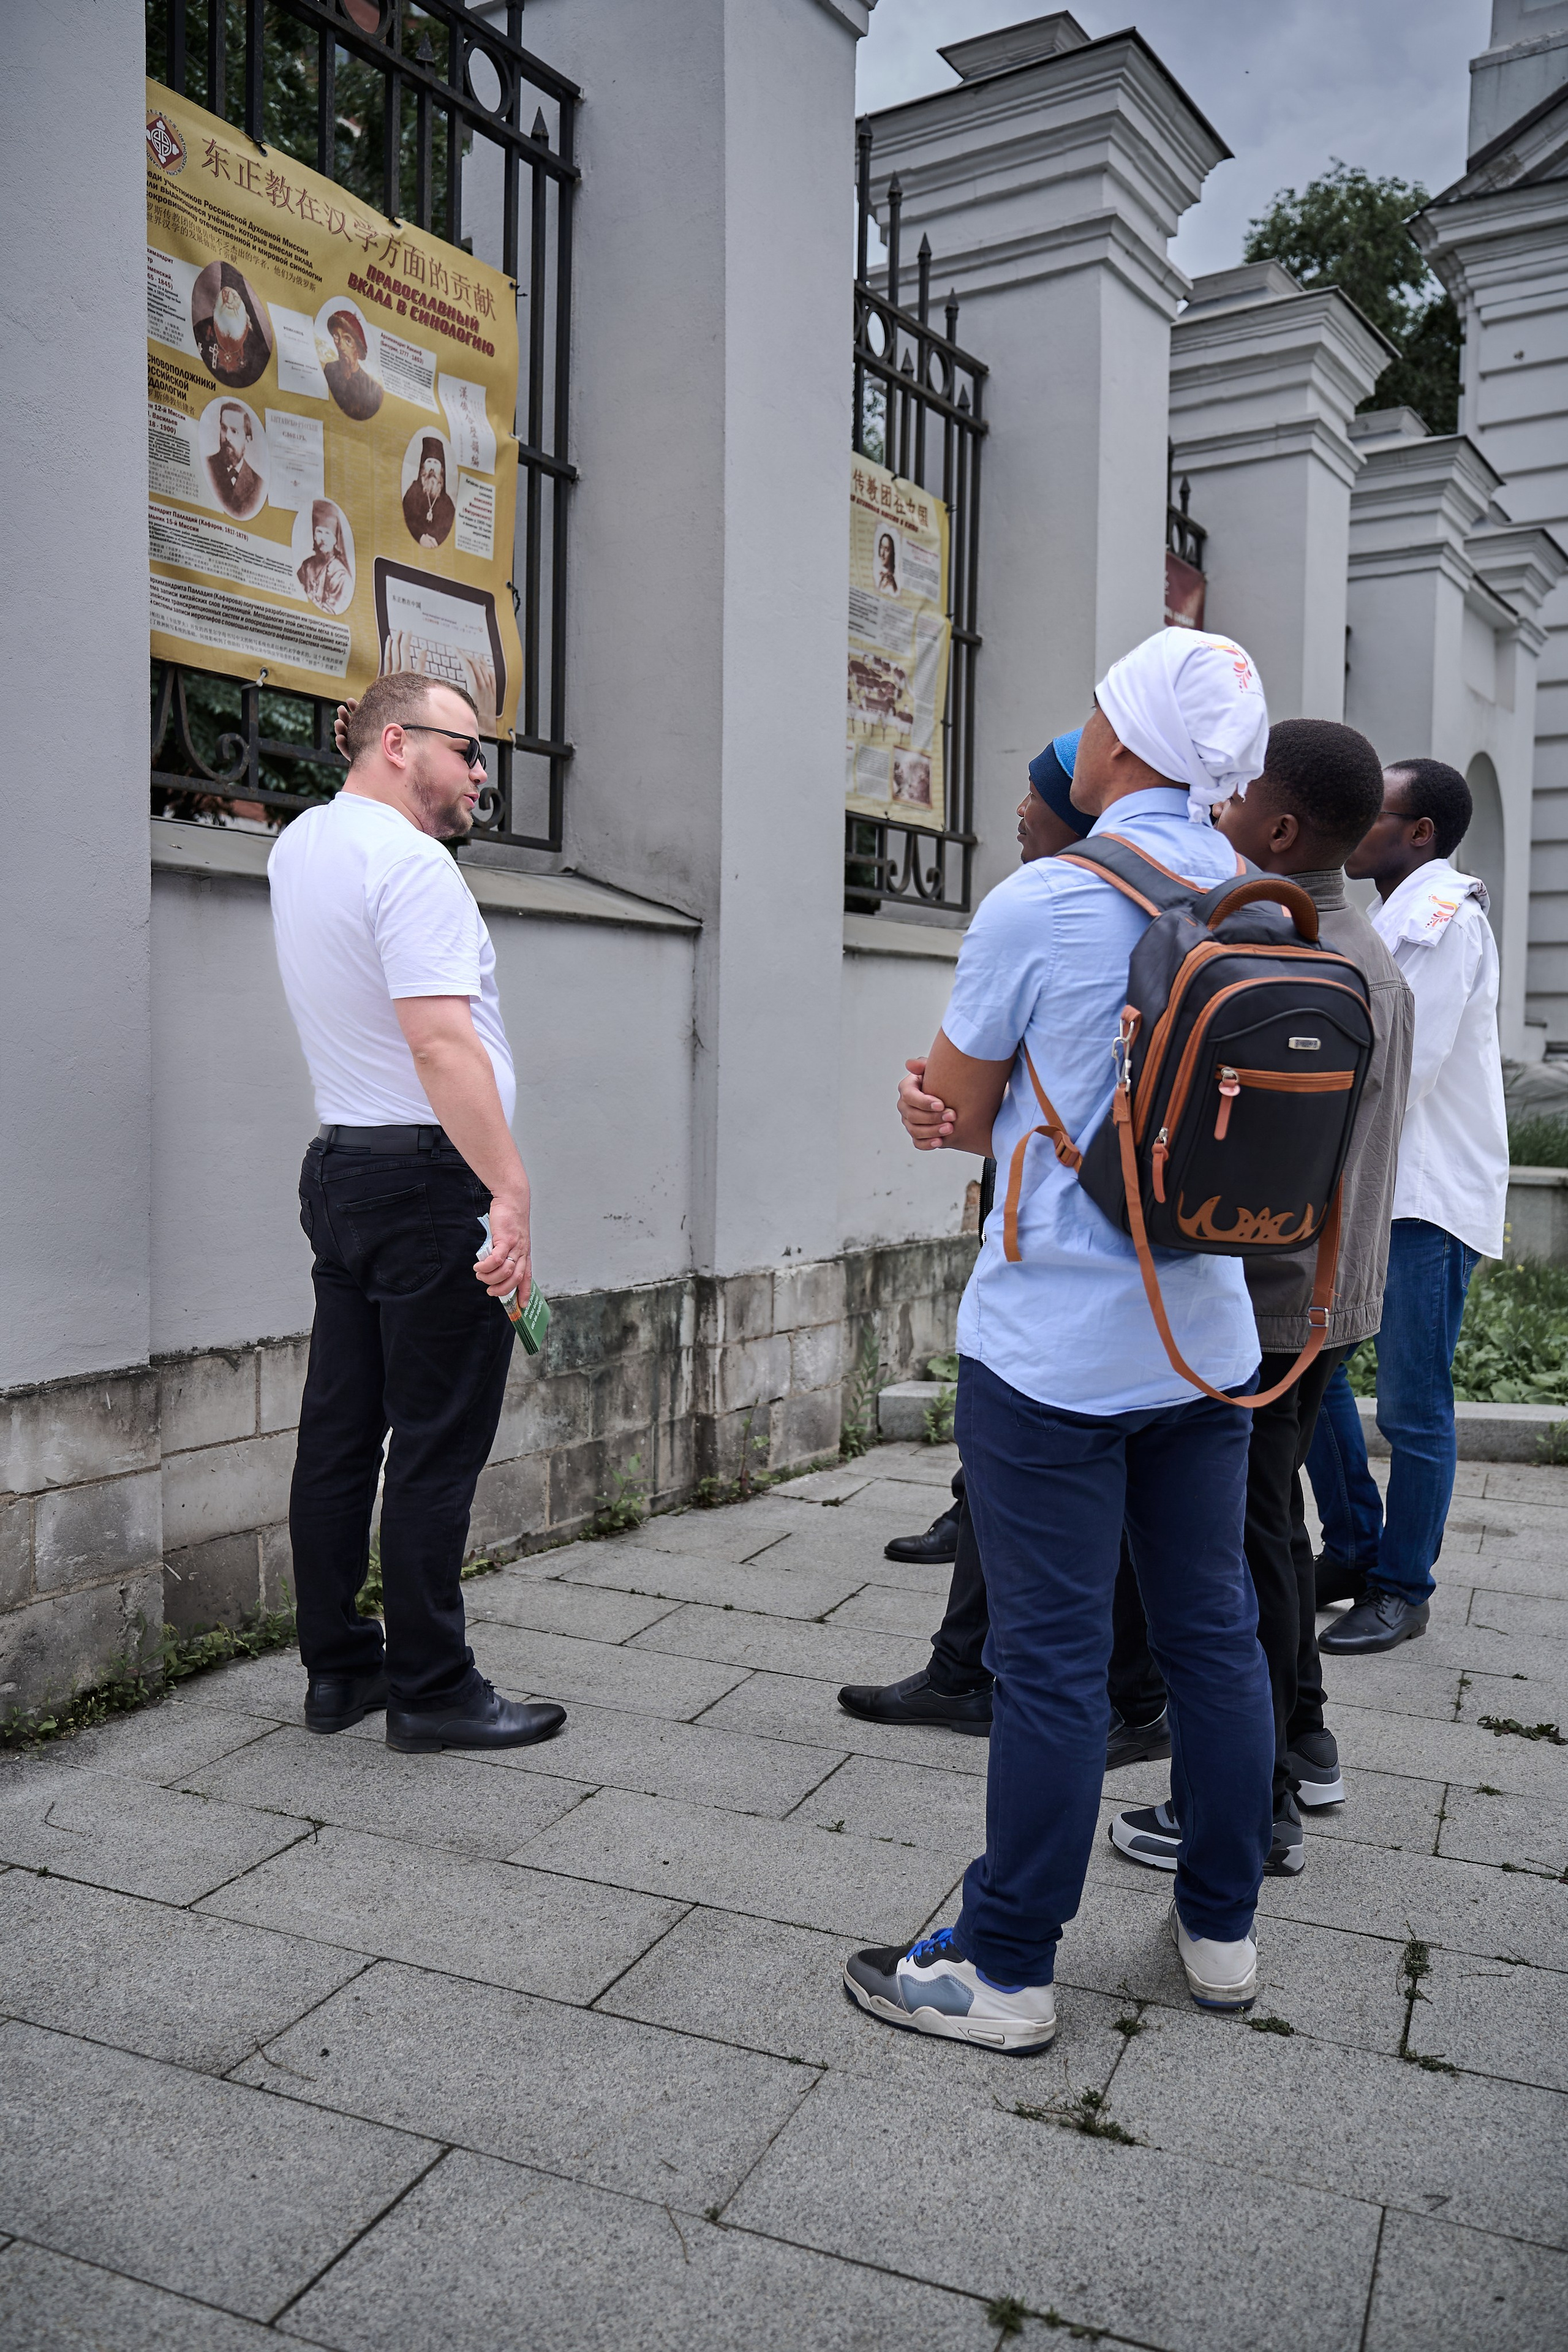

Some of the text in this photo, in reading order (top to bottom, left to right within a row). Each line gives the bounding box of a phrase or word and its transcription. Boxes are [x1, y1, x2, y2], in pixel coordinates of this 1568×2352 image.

[146, 170, 309, 256] еди участников Российской Духовной Миссии
[160, 186, 206, 217] выдающиеся
[208, 213, 236, 233] учёные,
[239, 227, 267, 246] которые
[269, 242, 293, 258] внесли
[295, 254, 313, 269] вклад
[202, 138, 496, 321] 东正教在汉学方面的贡献
[199, 218, 251, 248] отечественной
[258, 247, 288, 266] мировой
[290, 262, 323, 282] синологии
[158, 277, 173, 290] 1845)
[366, 264, 480, 334] ПРАВОСЛАВНЫЙ
[347, 272, 496, 357] ВКЛАД В СИНОЛОГИЮ
[153, 412, 178, 426] Васильев
[154, 404, 167, 413] 12-й
[168, 409, 186, 421] Миссии
[160, 424, 176, 435] 1900)
[173, 511, 198, 523] Палладий
[198, 519, 224, 532] (Кафаров,
[179, 522, 199, 532] Миссии
[153, 600, 172, 611] системы
[173, 607, 190, 616] записи
[190, 612, 221, 624] иероглифов
[225, 620, 249, 631] помощью
[249, 625, 276, 638] латинского
[276, 633, 298, 644] алфавита
[298, 638, 320, 648] (система
[160, 588, 178, 597] записи
[179, 593, 208, 605] китайских
[222, 604, 252, 616] кириллицей.
[253, 611, 284, 624] Методология
[297, 623, 317, 632] системы
[334, 633, 349, 642] основу
[172, 599, 221, 616] транскрипционных
[222, 612, 239, 622] систем
[245, 617, 283, 631] опосредованно
[283, 627, 305, 637] повлияла
[312, 635, 334, 644] создание
[187, 586, 213, 598] Палладия
[213, 592, 243, 606] (Кафарова)
[243, 601, 265, 611] получила
[265, 606, 301, 620] разработанная
[308, 618, 349, 633] транскрипционная
